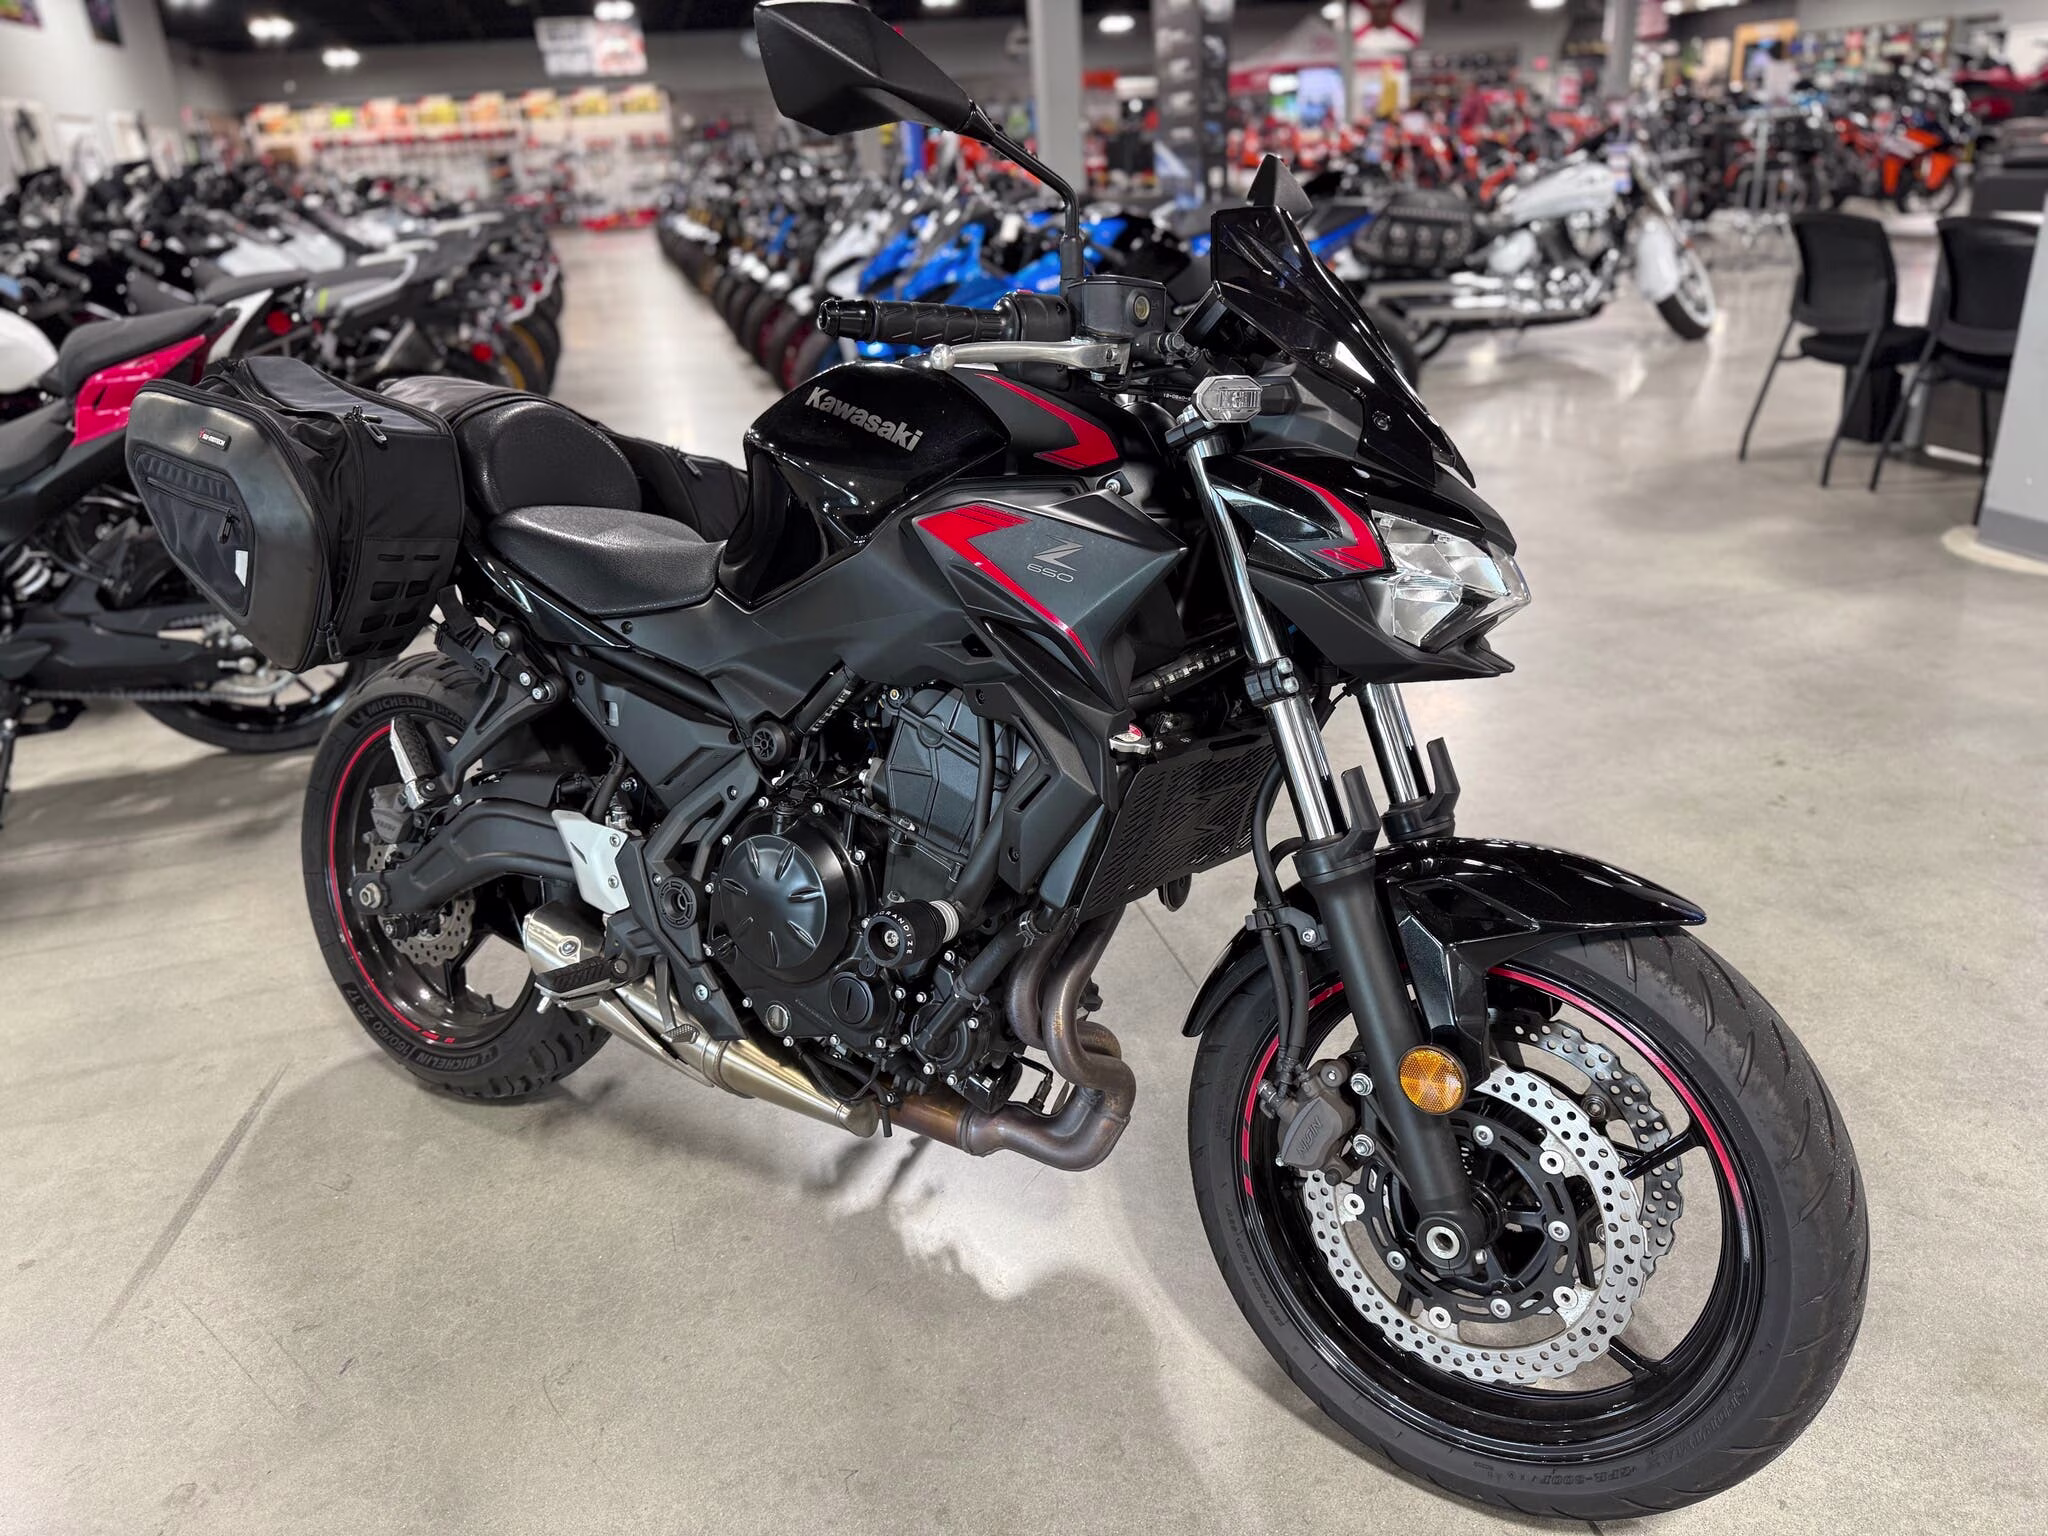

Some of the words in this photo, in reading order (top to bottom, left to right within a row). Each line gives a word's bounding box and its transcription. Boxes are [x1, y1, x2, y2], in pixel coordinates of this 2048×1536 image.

[805, 386, 923, 452] Kawasaki
[1026, 563, 1074, 583] 650
[366, 696, 428, 716] MICHELIN
[345, 988, 361, 1005] 17
[357, 1003, 373, 1019] ZR
[372, 1021, 411, 1055] 160/60
[416, 1053, 479, 1071] MICHELIN
[1296, 1115, 1322, 1157] NISSIN
